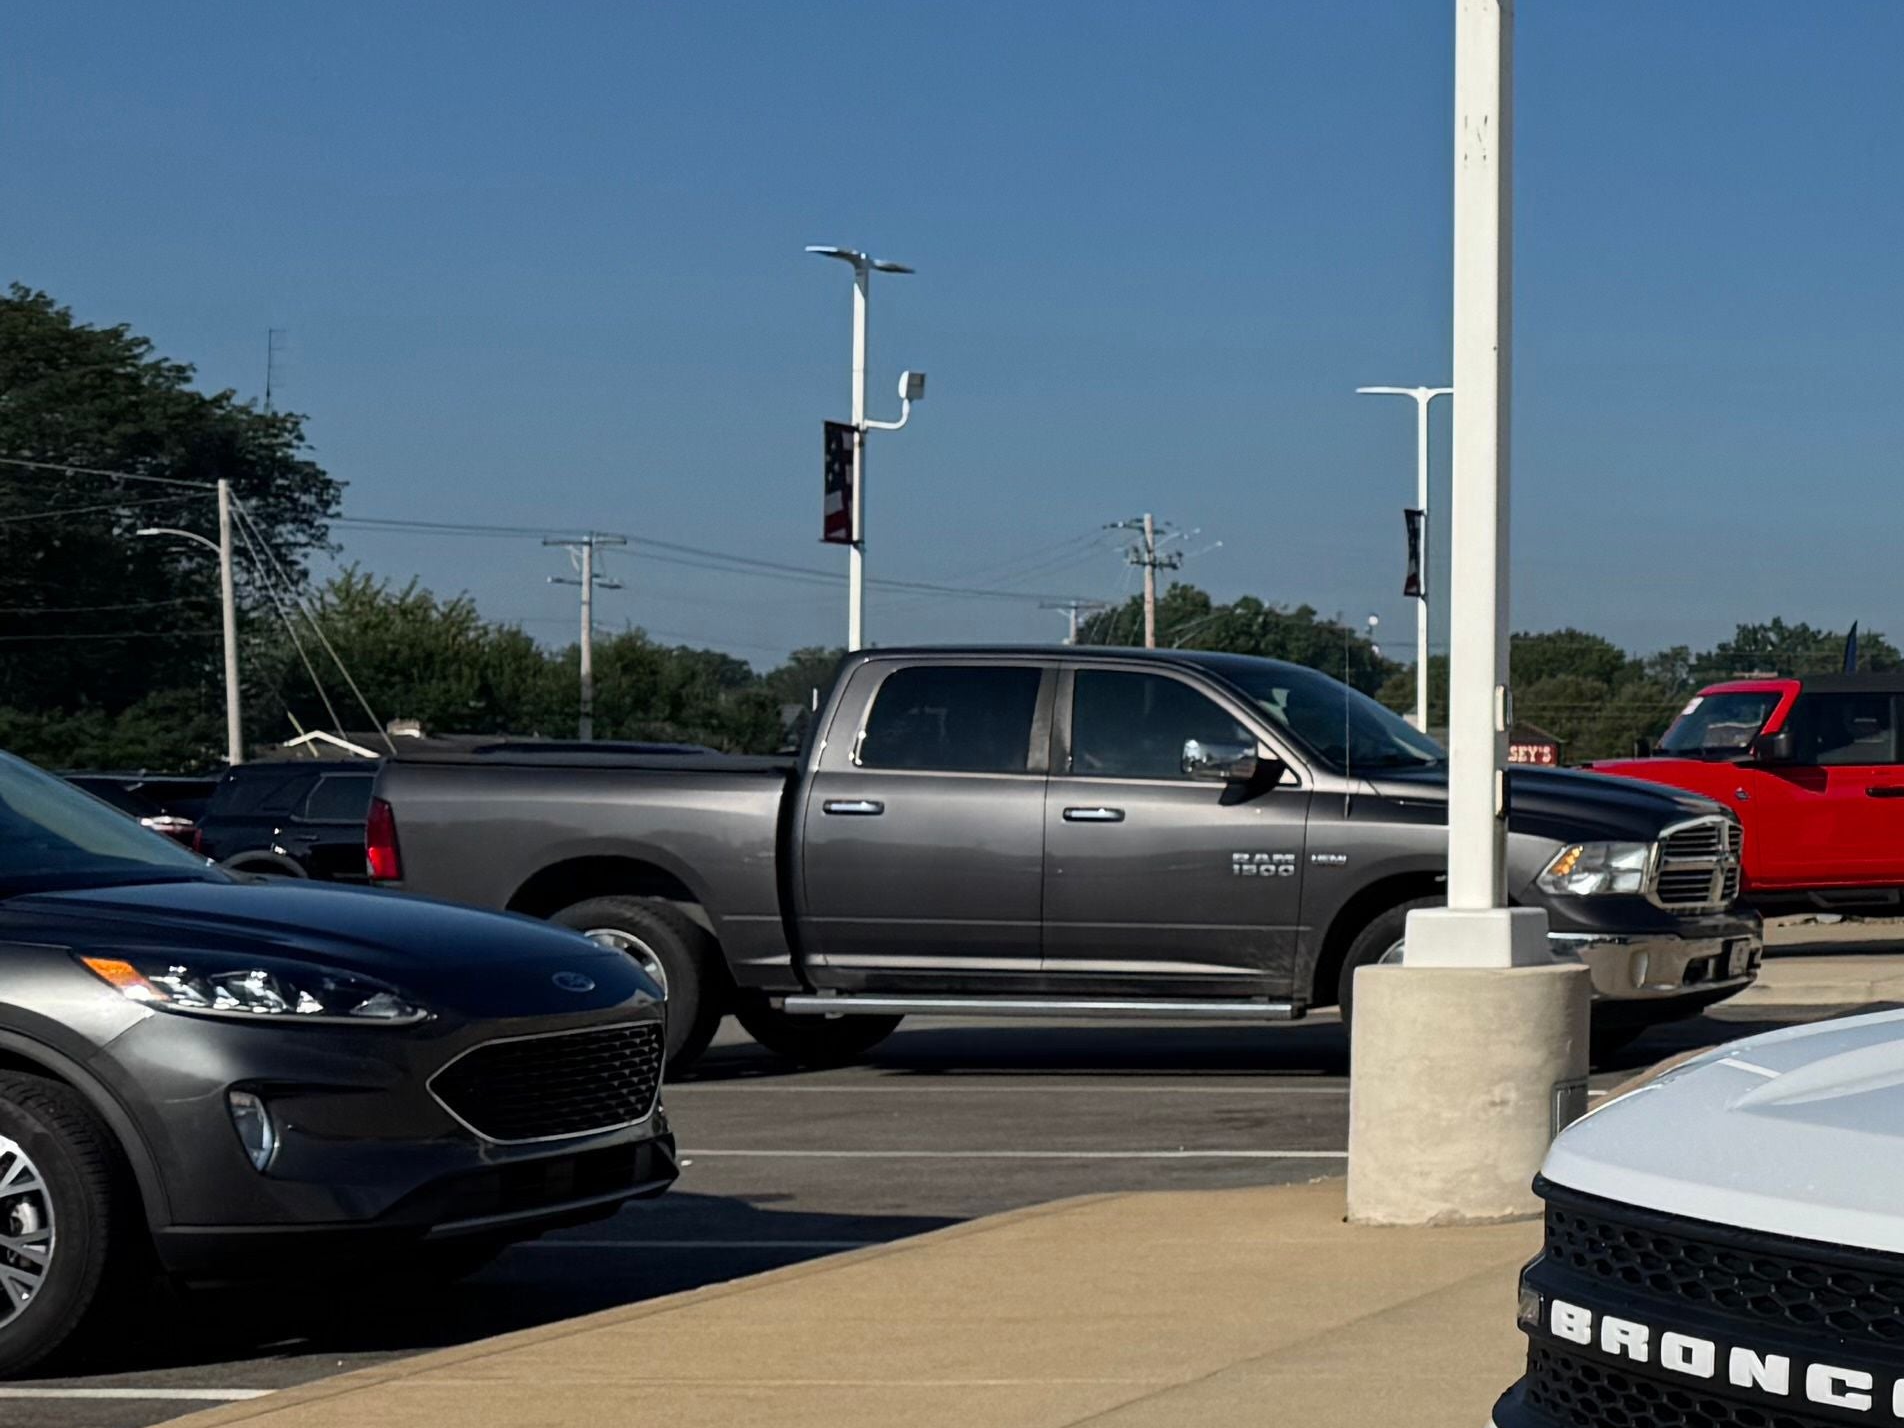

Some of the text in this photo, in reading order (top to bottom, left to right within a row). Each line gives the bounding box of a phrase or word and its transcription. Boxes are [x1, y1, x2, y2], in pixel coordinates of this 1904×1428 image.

[1507, 745, 1552, 762] SEY'S
[1232, 853, 1295, 863] RAM
[1233, 864, 1295, 876] 1500
